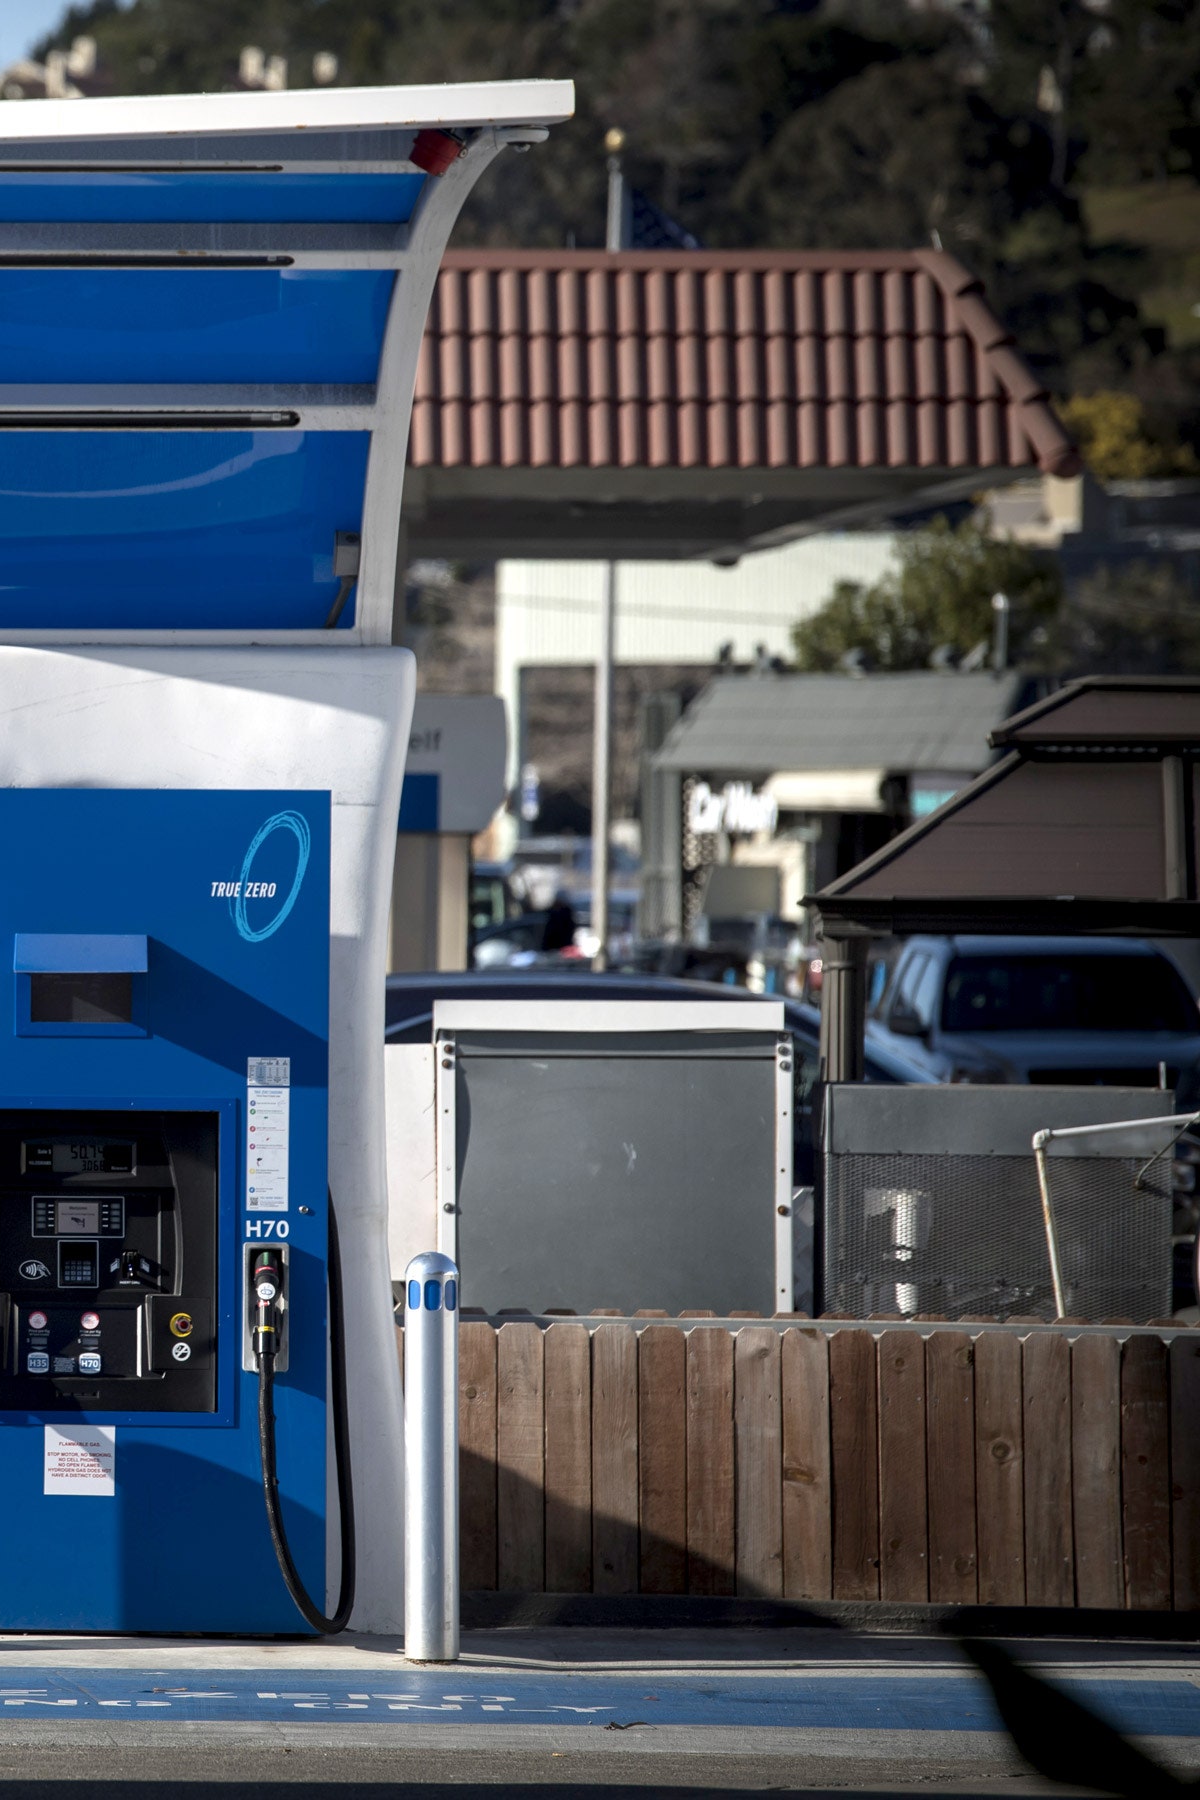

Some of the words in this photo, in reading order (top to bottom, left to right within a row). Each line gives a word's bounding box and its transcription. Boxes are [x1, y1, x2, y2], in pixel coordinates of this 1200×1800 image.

[211, 882, 242, 897] TRUE
[245, 882, 277, 898] ZERO
[246, 1220, 290, 1238] H70
[29, 1359, 47, 1367] H35
[81, 1360, 98, 1368] H70
[164, 1691, 515, 1702] ZERO
[294, 1702, 618, 1713] ONLY
